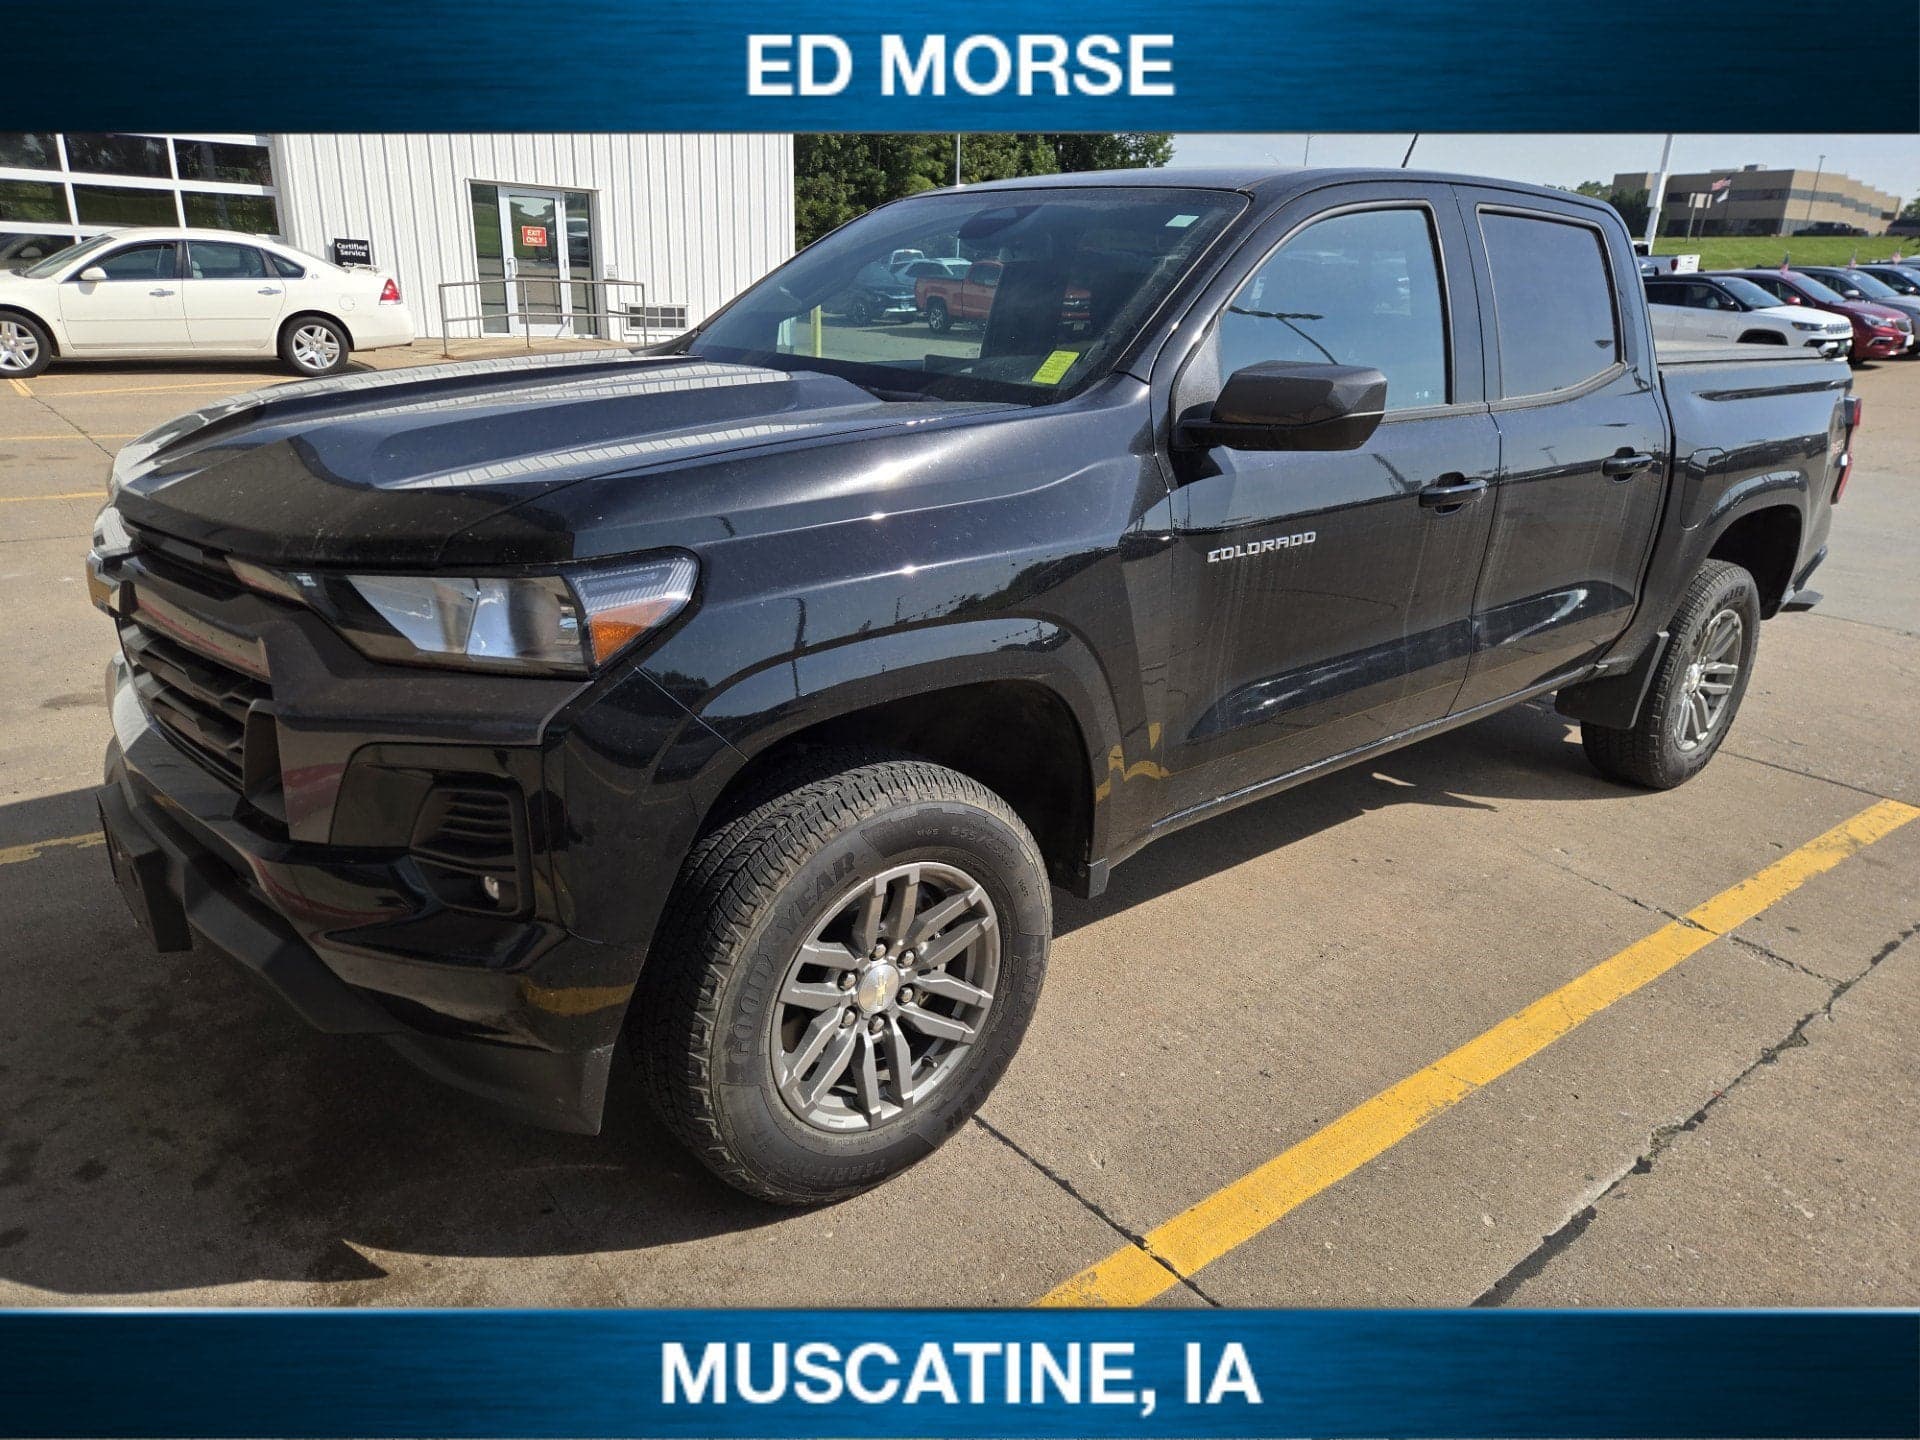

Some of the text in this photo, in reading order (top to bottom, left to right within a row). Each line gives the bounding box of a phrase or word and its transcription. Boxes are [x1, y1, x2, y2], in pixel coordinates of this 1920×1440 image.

[336, 242, 368, 250] Certified
[340, 249, 366, 257] Service
[1207, 531, 1317, 563] COLORADO
